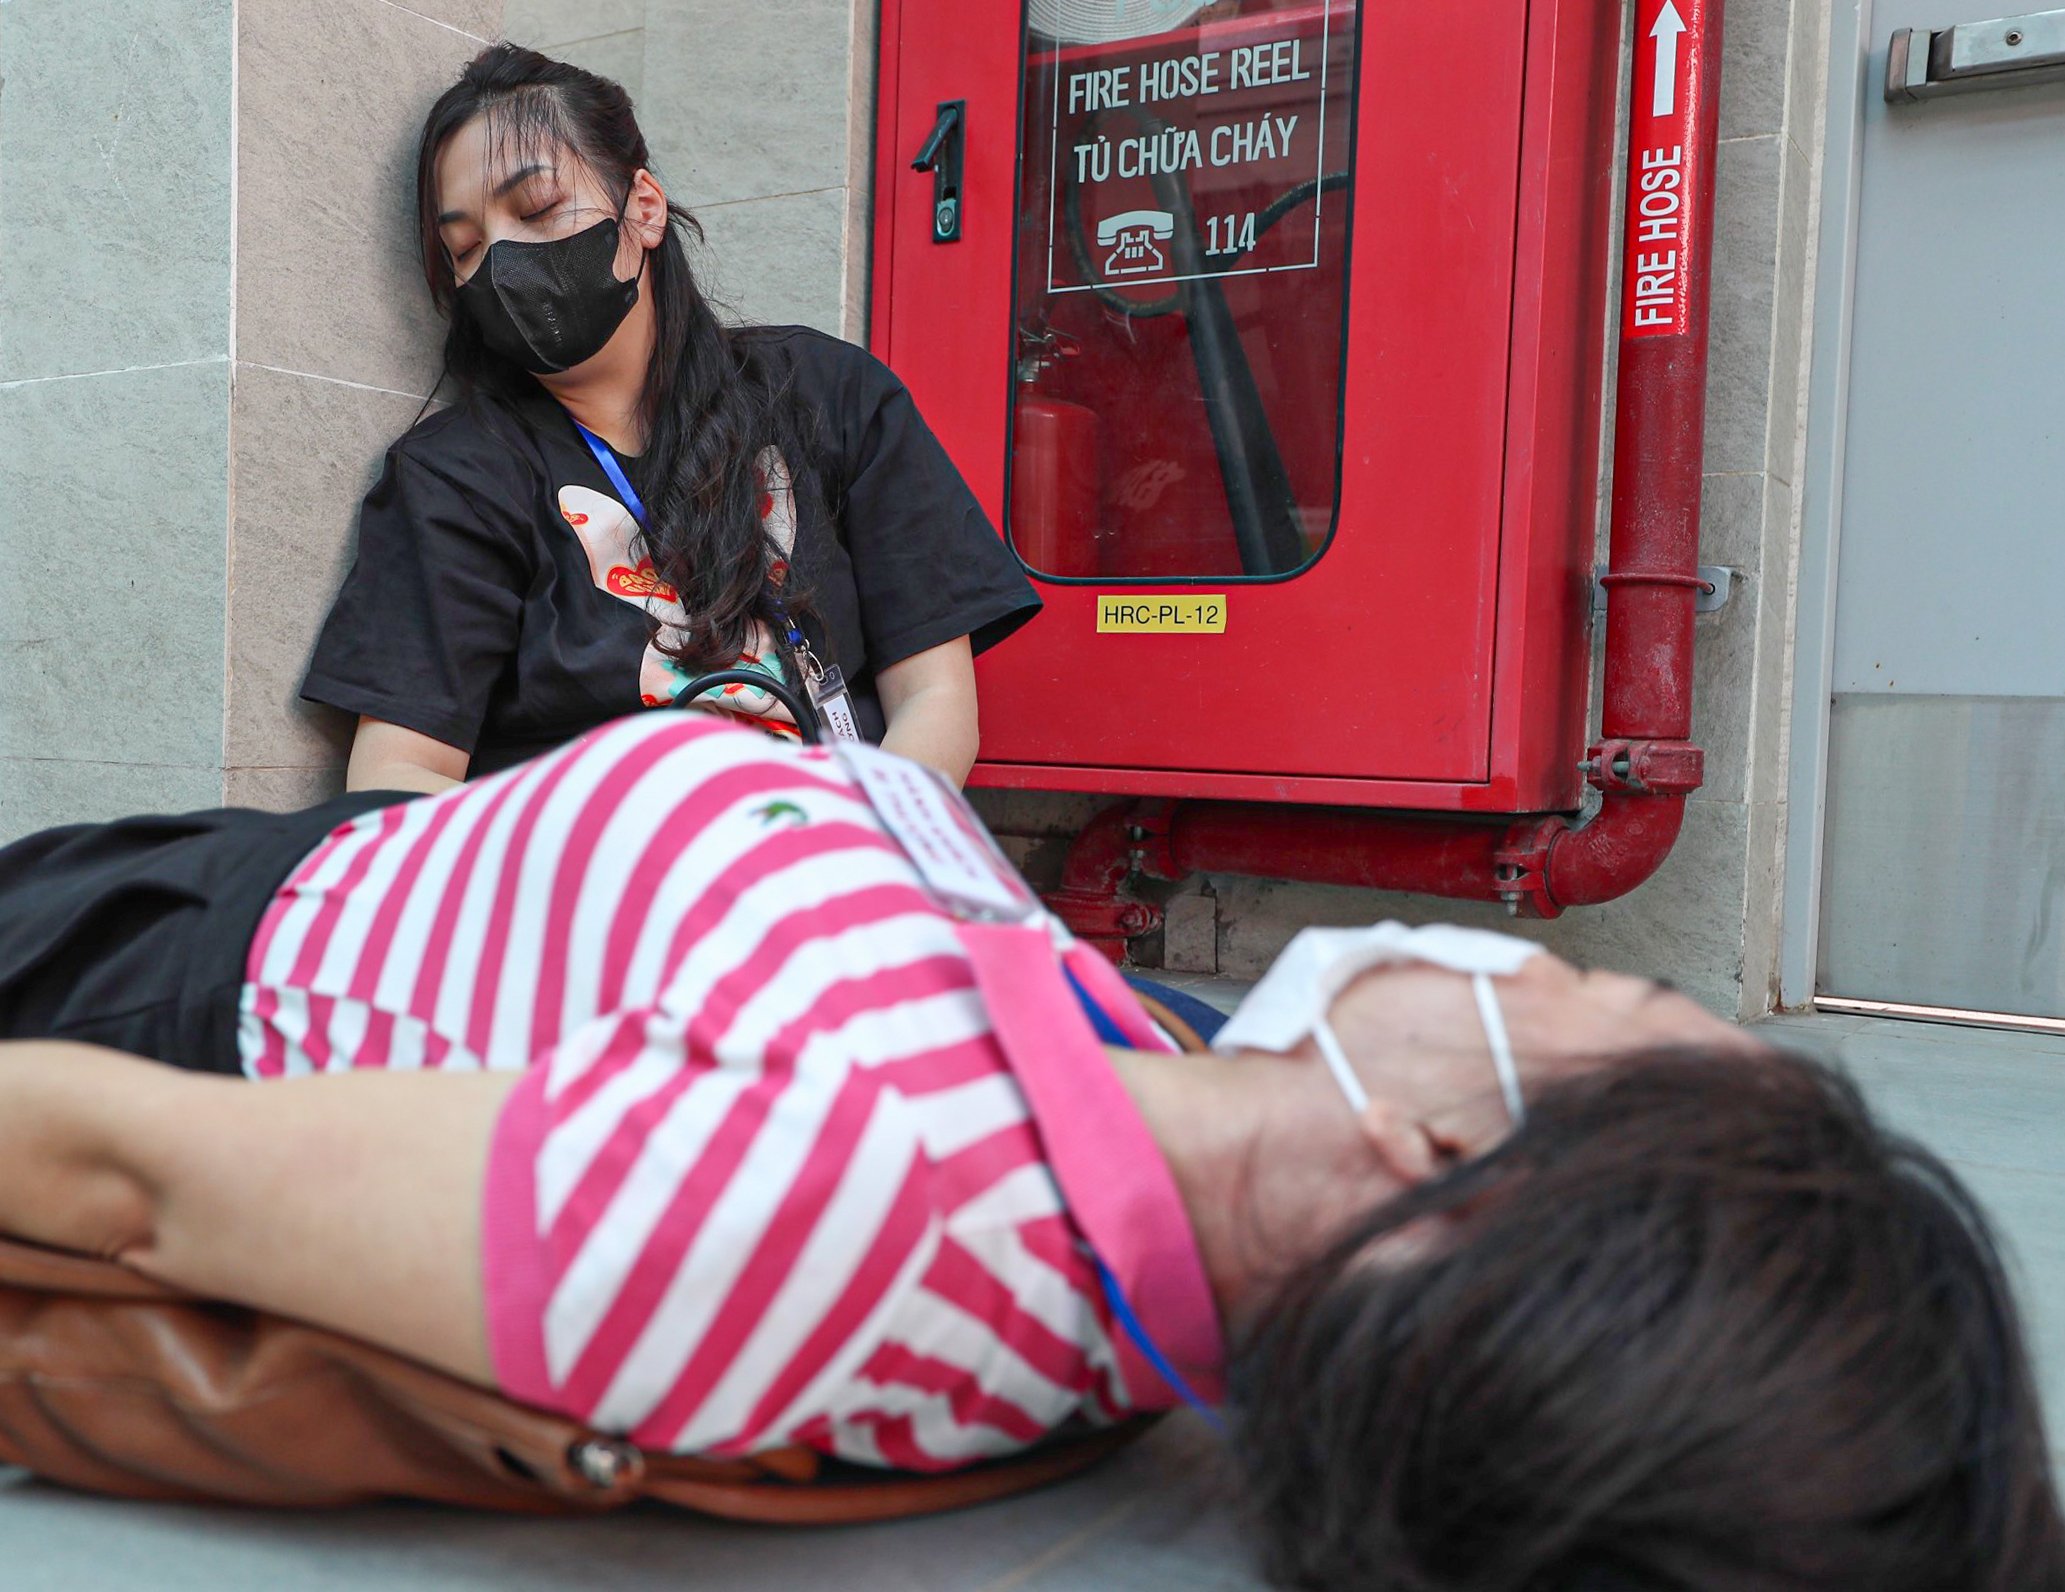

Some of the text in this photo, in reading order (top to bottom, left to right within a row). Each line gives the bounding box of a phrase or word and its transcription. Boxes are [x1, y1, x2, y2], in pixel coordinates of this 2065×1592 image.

[1069, 39, 1310, 114] FIRE HOSE REEL
[1074, 112, 1298, 183] TỦ CHỮA CHÁY
[1205, 212, 1257, 256] 114
[1635, 145, 1682, 327] FIRE HOSE
[1104, 605, 1218, 624] HRC-PL-12
